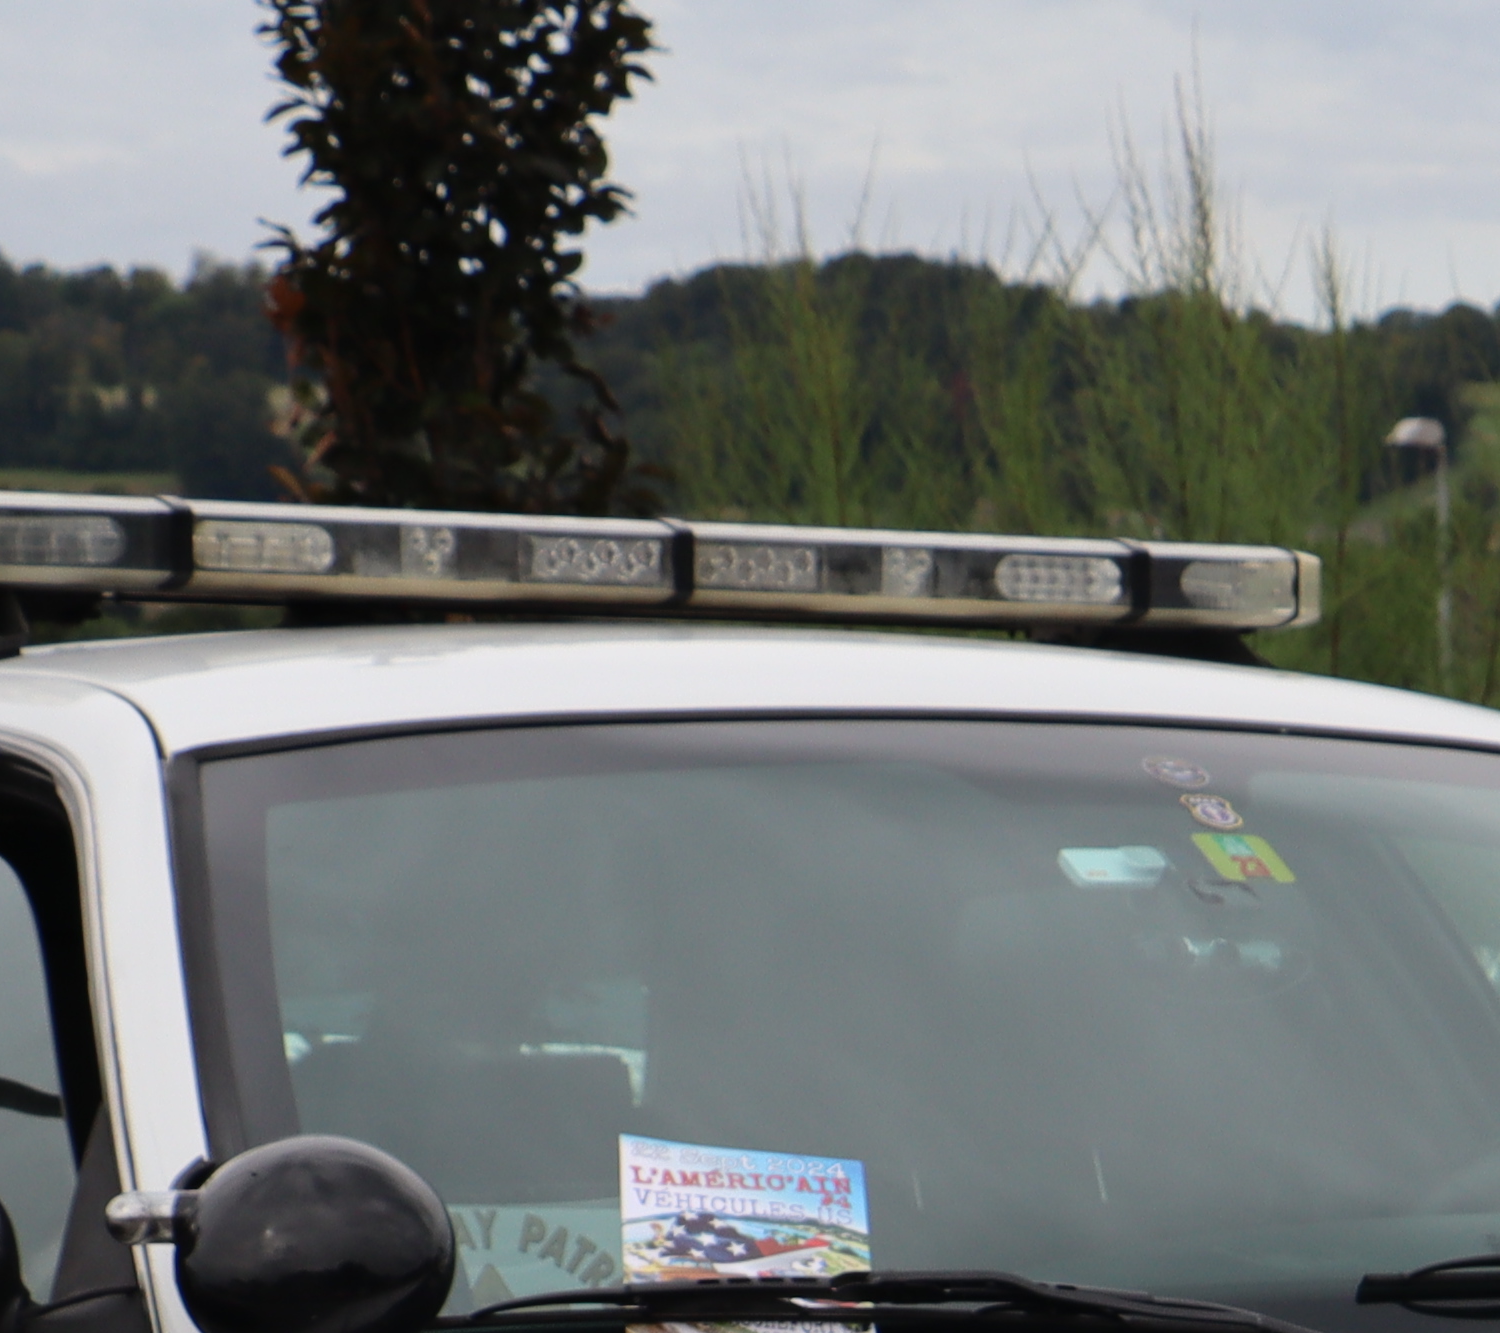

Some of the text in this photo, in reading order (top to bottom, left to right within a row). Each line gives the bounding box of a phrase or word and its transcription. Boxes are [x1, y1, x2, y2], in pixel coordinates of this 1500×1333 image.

[678, 1146, 756, 1173] Sept
[767, 1155, 846, 1178] 2024
[633, 1188, 852, 1226] VÉHICULES US
[518, 1212, 623, 1288] PATR
